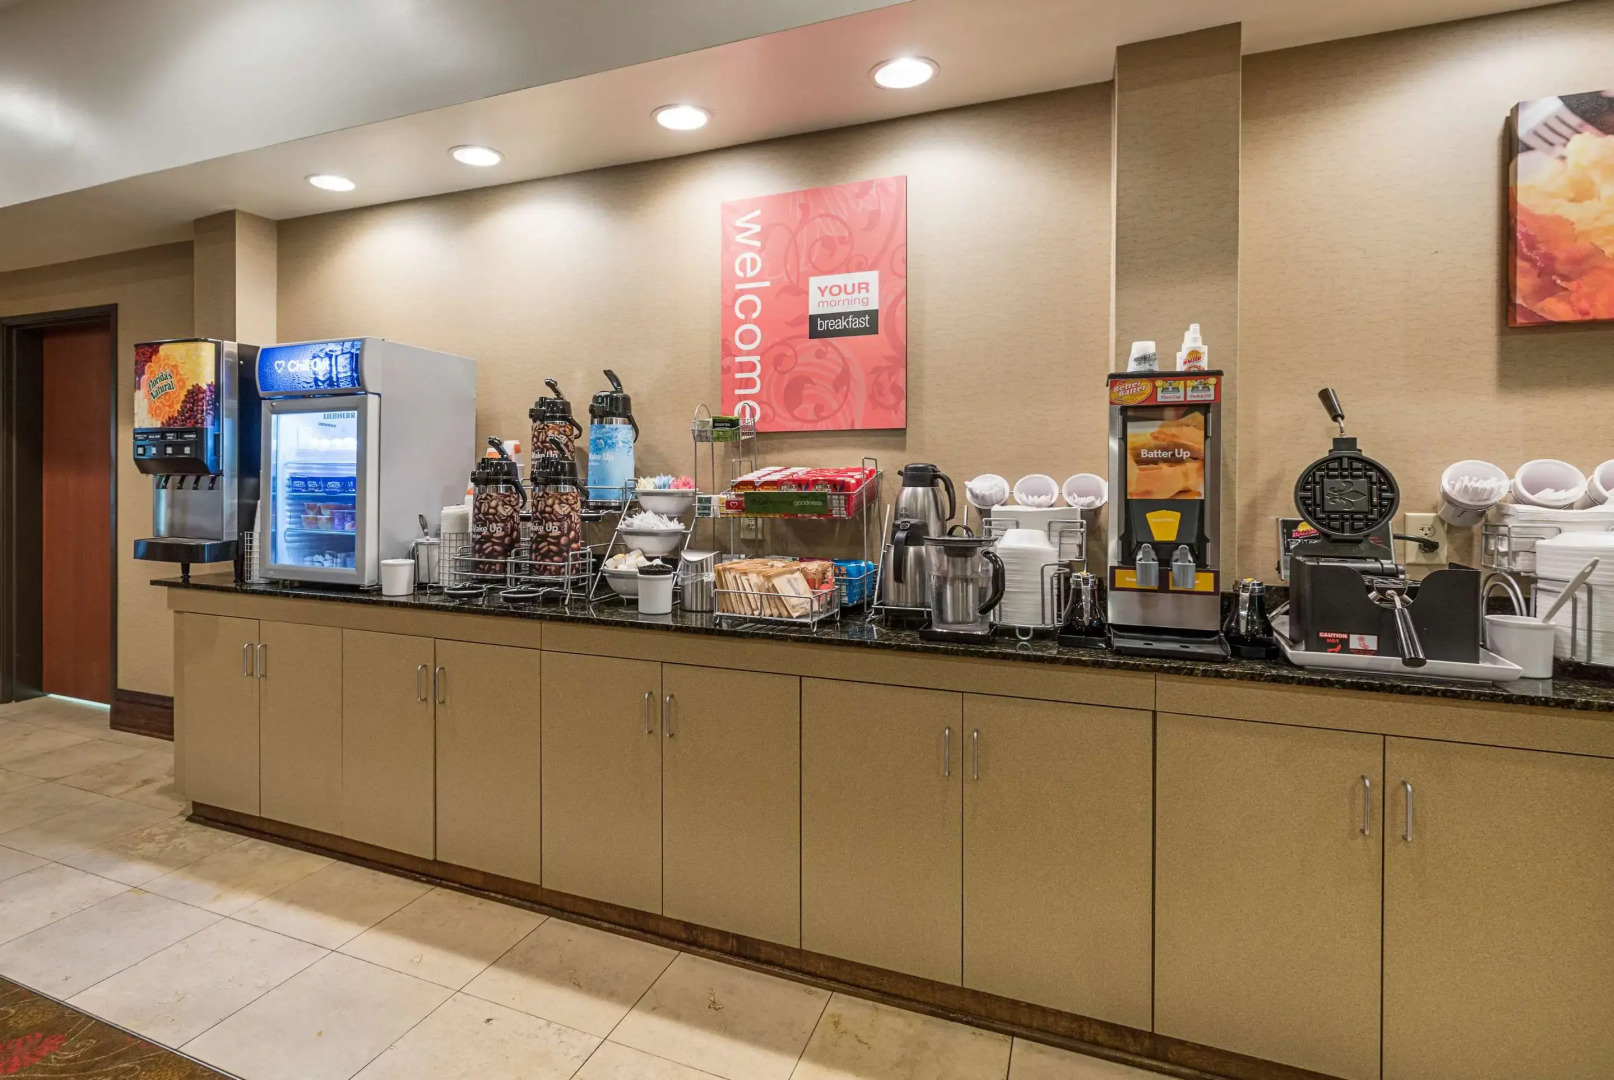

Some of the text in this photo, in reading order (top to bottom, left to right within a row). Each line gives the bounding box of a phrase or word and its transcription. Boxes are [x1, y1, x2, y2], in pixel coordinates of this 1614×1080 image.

[817, 282, 870, 297] YOUR
[817, 296, 869, 308] morning
[734, 209, 771, 425] welcome
[817, 314, 870, 331] breakfast
[287, 360, 310, 372] Chill
[323, 412, 356, 420] LIEBHERR
[602, 452, 614, 461] Up
[1141, 448, 1191, 460] Batter Up
[489, 523, 503, 534] Up
[545, 523, 559, 534] Up
